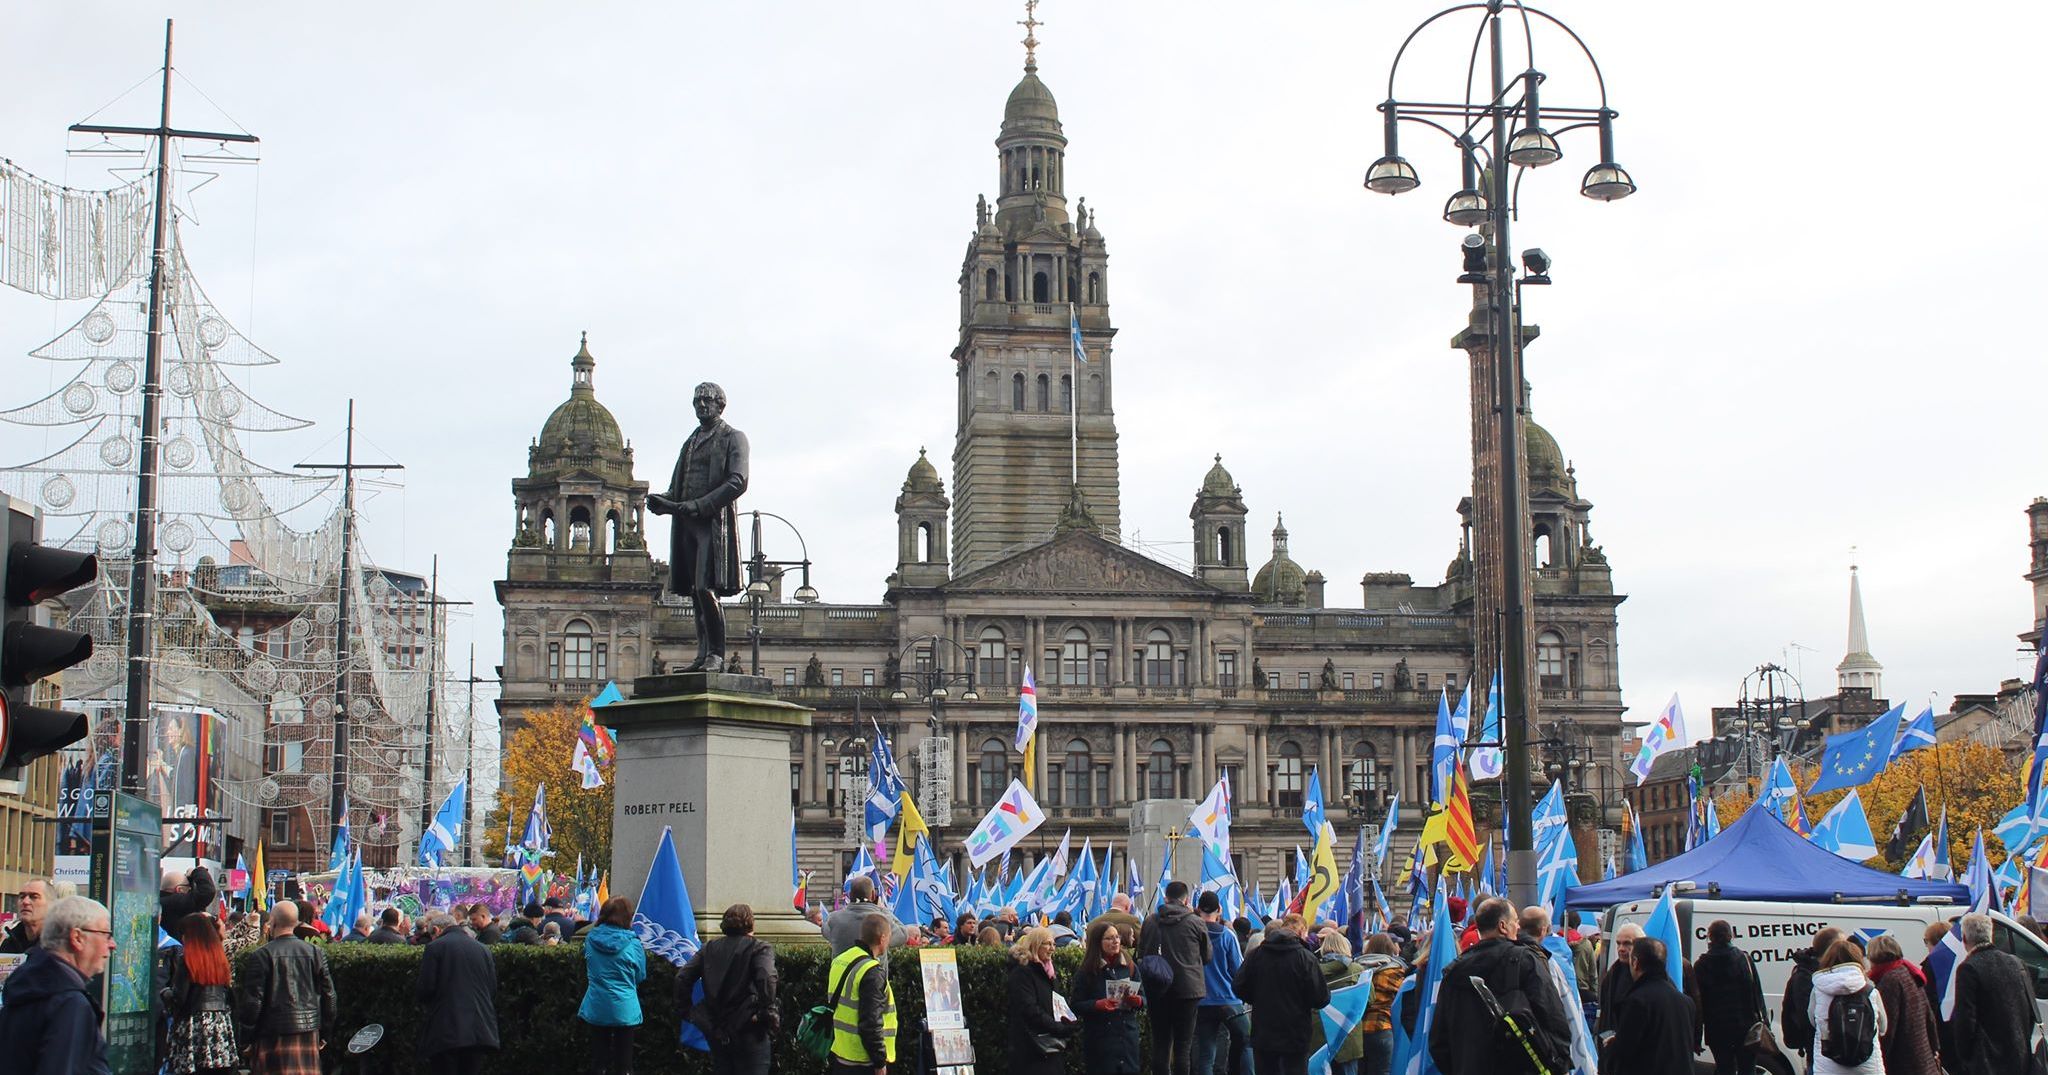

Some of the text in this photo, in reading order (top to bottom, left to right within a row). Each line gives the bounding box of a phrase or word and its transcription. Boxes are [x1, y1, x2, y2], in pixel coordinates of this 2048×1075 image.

[624, 802, 696, 816] ROBERT PEEL
[1750, 948, 1795, 962] OTLA
